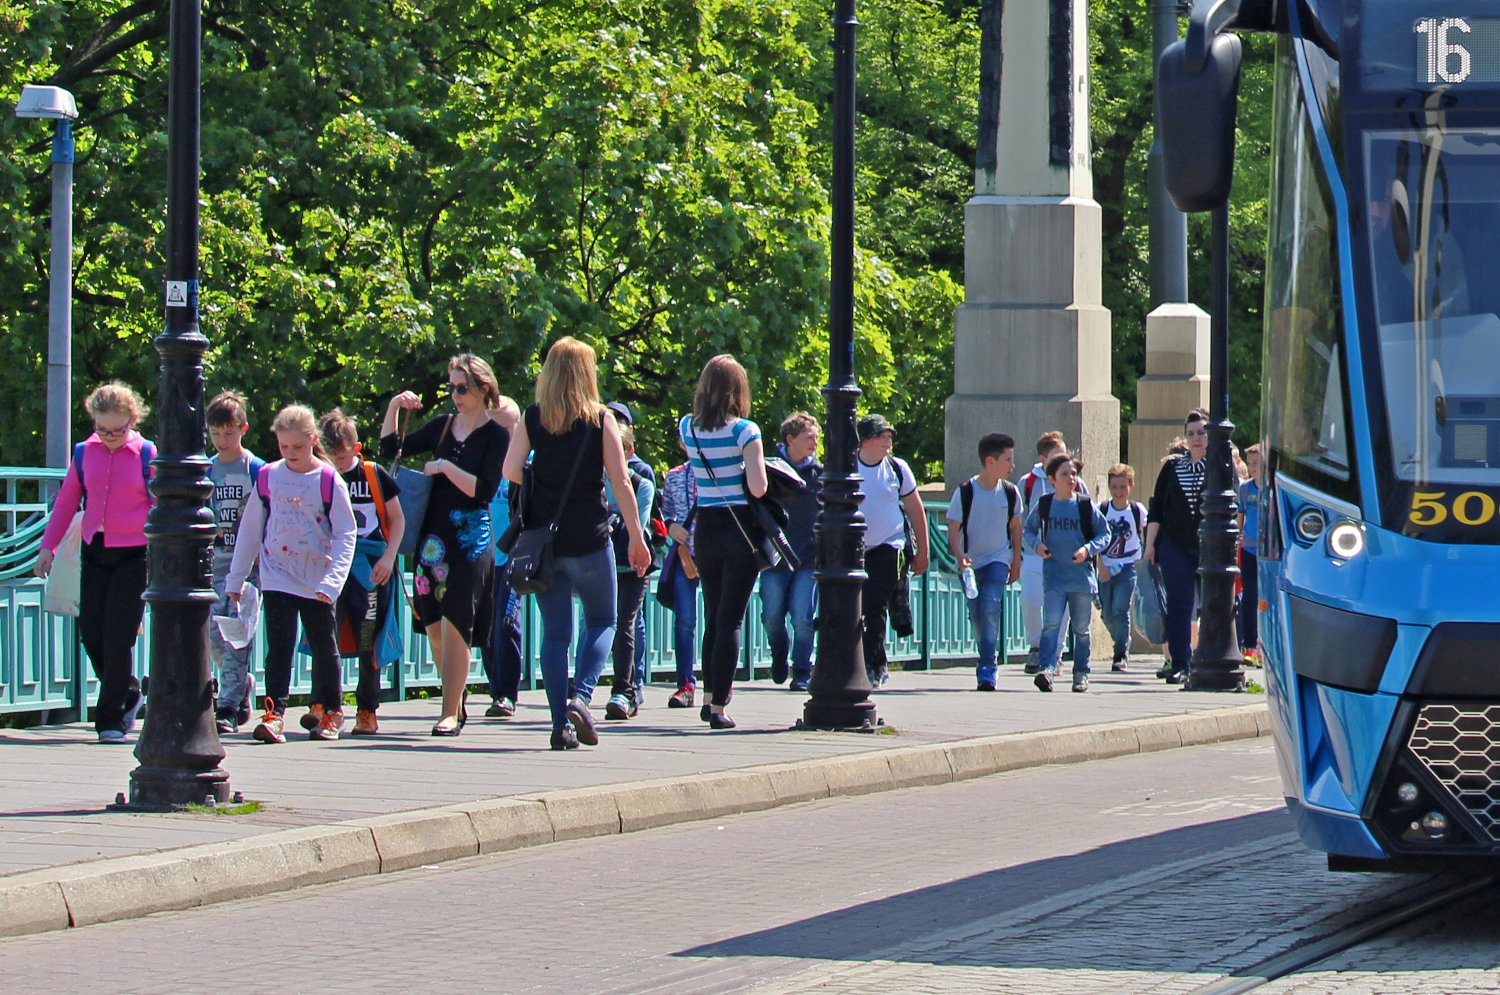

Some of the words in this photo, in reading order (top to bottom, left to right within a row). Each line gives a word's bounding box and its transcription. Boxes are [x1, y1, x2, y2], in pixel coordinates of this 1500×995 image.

[1415, 17, 1471, 84] 16
[216, 486, 242, 500] HERE
[346, 481, 372, 498] ALL
[220, 509, 237, 522] WE
[223, 533, 236, 546] GO
